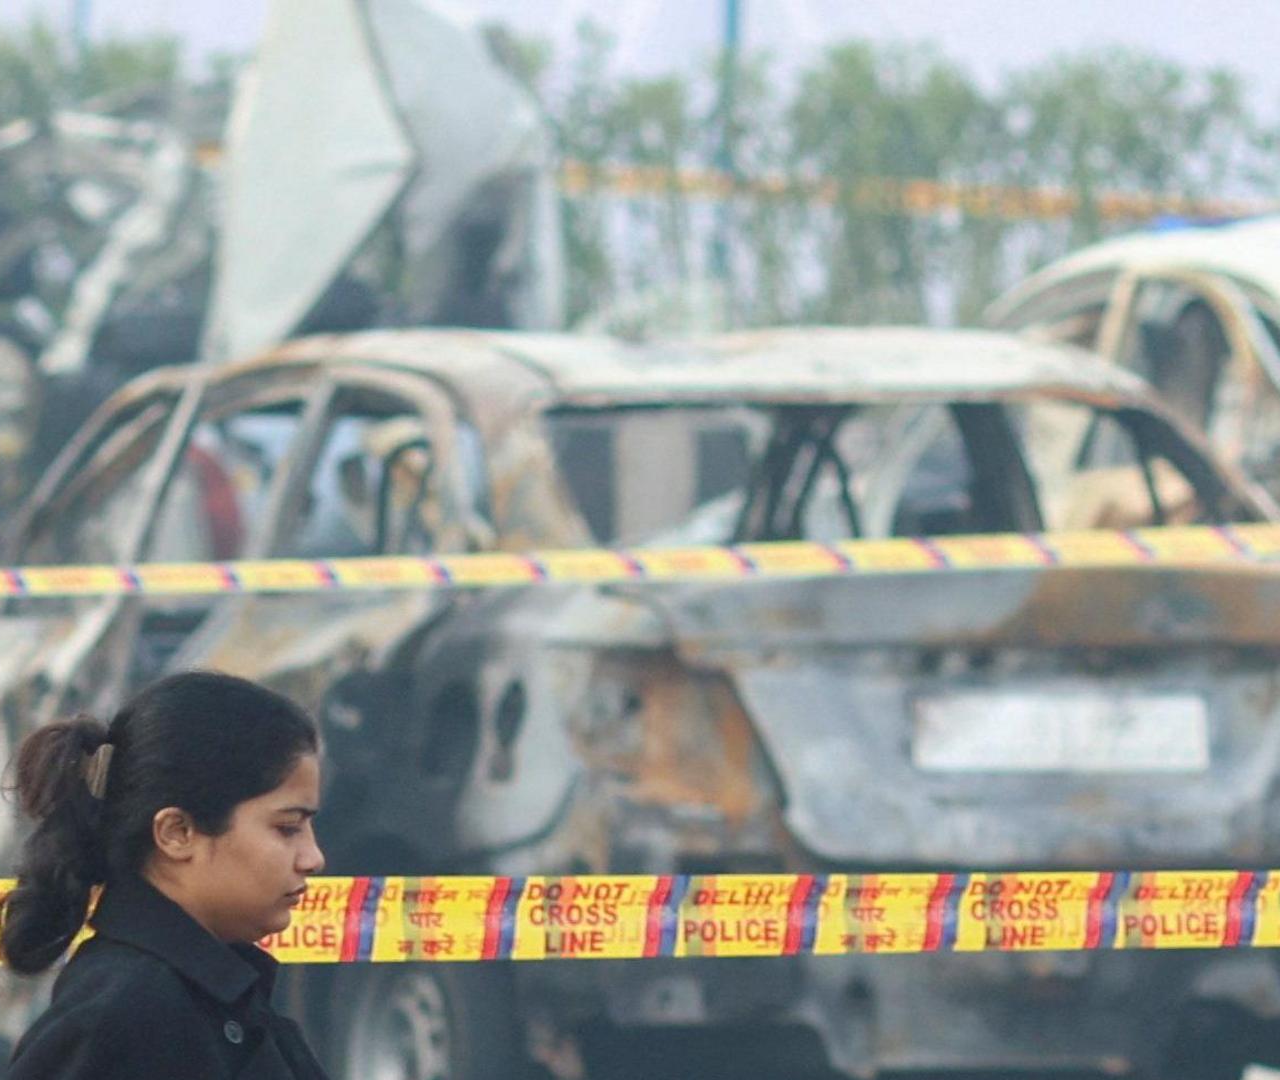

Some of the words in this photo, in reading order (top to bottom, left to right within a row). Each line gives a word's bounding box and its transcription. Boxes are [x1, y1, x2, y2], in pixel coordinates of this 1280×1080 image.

[526, 883, 562, 901] DO
[572, 883, 631, 901] NOT
[529, 903, 618, 925] CROSS
[970, 899, 1059, 921] CROSS
[682, 920, 779, 942] POLICE
[1123, 914, 1218, 936] POLICE
[544, 931, 604, 953] LINE
[985, 926, 1045, 947] LINE
